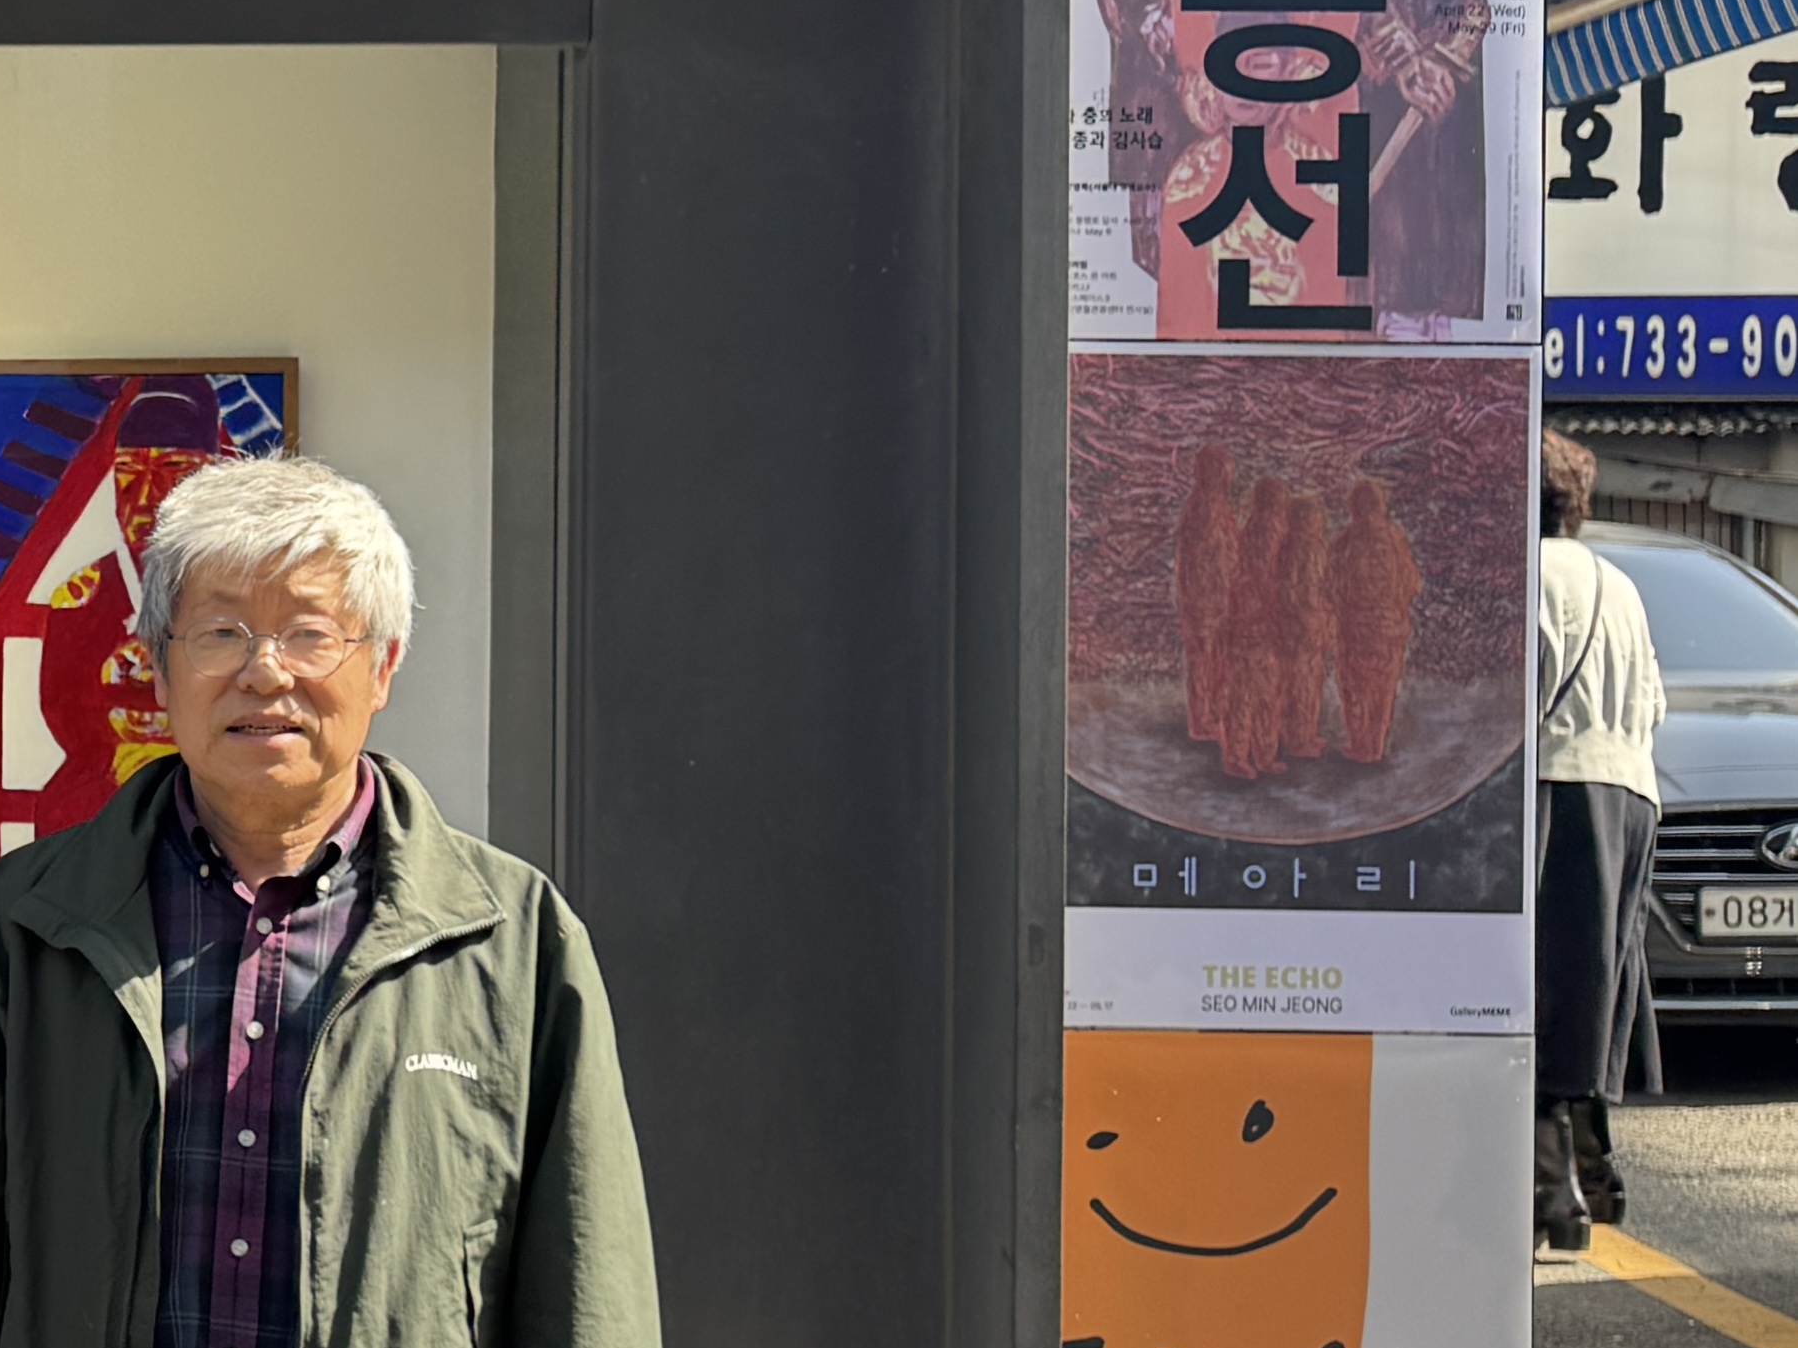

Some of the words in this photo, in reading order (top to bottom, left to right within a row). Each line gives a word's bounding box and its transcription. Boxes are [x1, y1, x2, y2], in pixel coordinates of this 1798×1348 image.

[1120, 106, 1153, 125] 노래
[1112, 131, 1163, 150] 김시습
[1202, 965, 1256, 989] THE
[1265, 965, 1343, 990] ECHO
[1201, 994, 1237, 1013] SEO
[1242, 996, 1276, 1013] MIN
[1280, 996, 1343, 1014] JEONG
